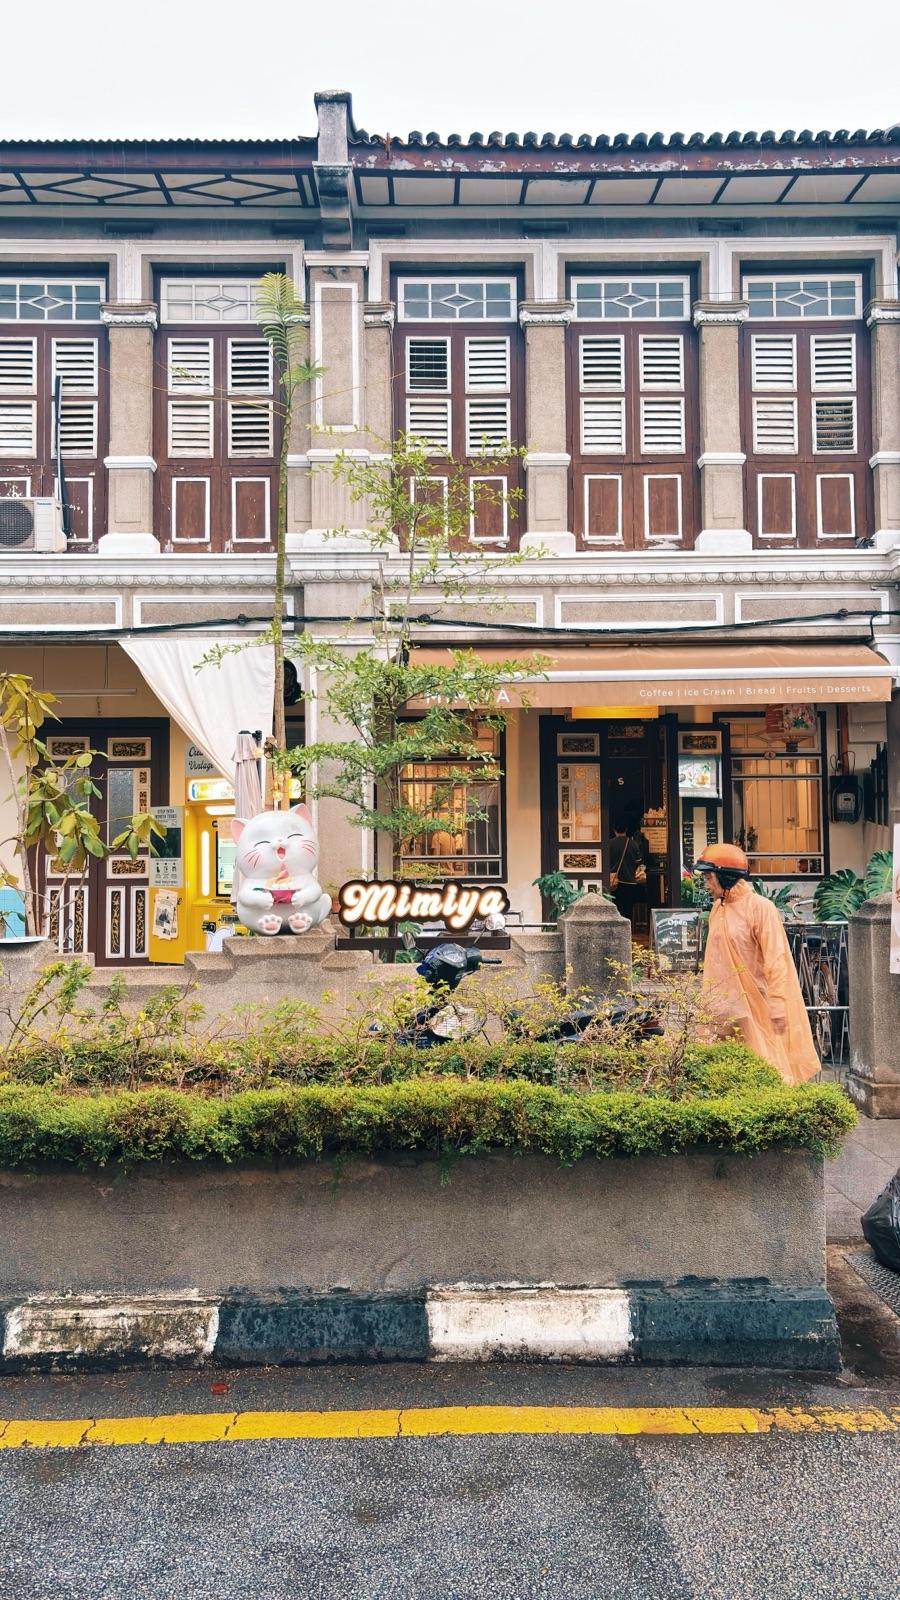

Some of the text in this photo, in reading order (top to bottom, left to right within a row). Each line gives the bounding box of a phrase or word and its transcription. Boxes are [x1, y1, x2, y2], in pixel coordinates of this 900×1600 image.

[639, 689, 674, 697] Coffee
[684, 688, 700, 696] Ice
[703, 688, 736, 696] Cream
[786, 686, 817, 694] Fruits
[827, 685, 872, 693] Desserts
[342, 883, 507, 929] Mimiya
[667, 919, 688, 927] Open
